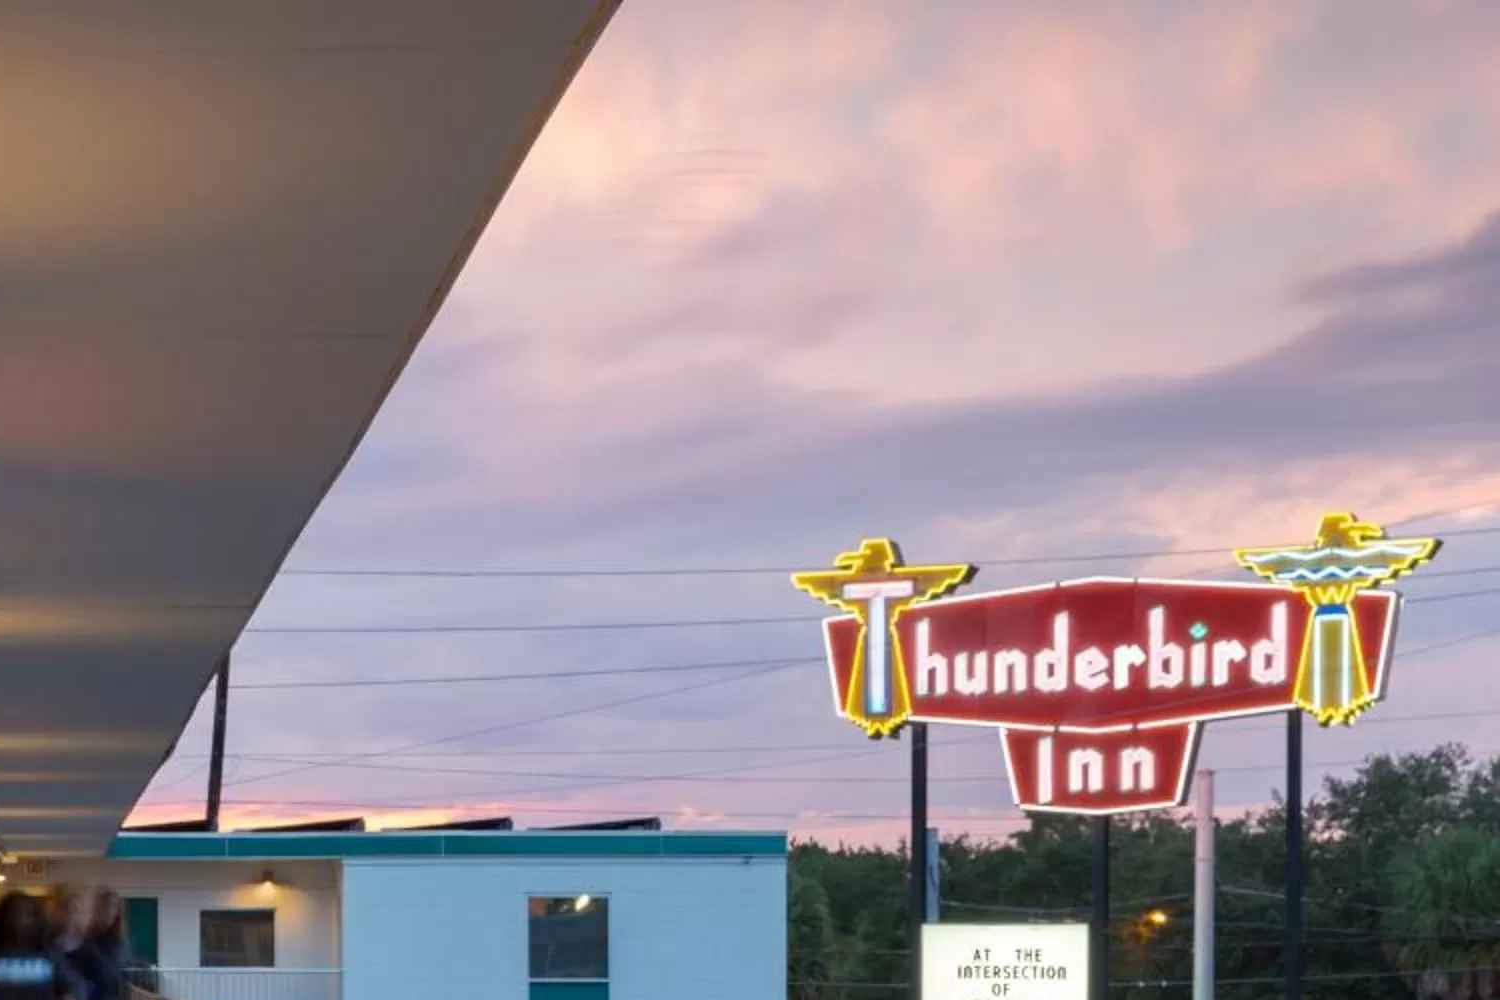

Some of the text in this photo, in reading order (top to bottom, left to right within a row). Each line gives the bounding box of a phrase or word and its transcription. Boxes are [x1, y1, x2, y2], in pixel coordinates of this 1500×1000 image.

[842, 580, 1288, 714] Thunderbird
[1037, 735, 1156, 804] Inn
[973, 948, 1042, 962] AT THE
[957, 965, 1068, 980] INTERSECTION
[991, 983, 1011, 997] OF
